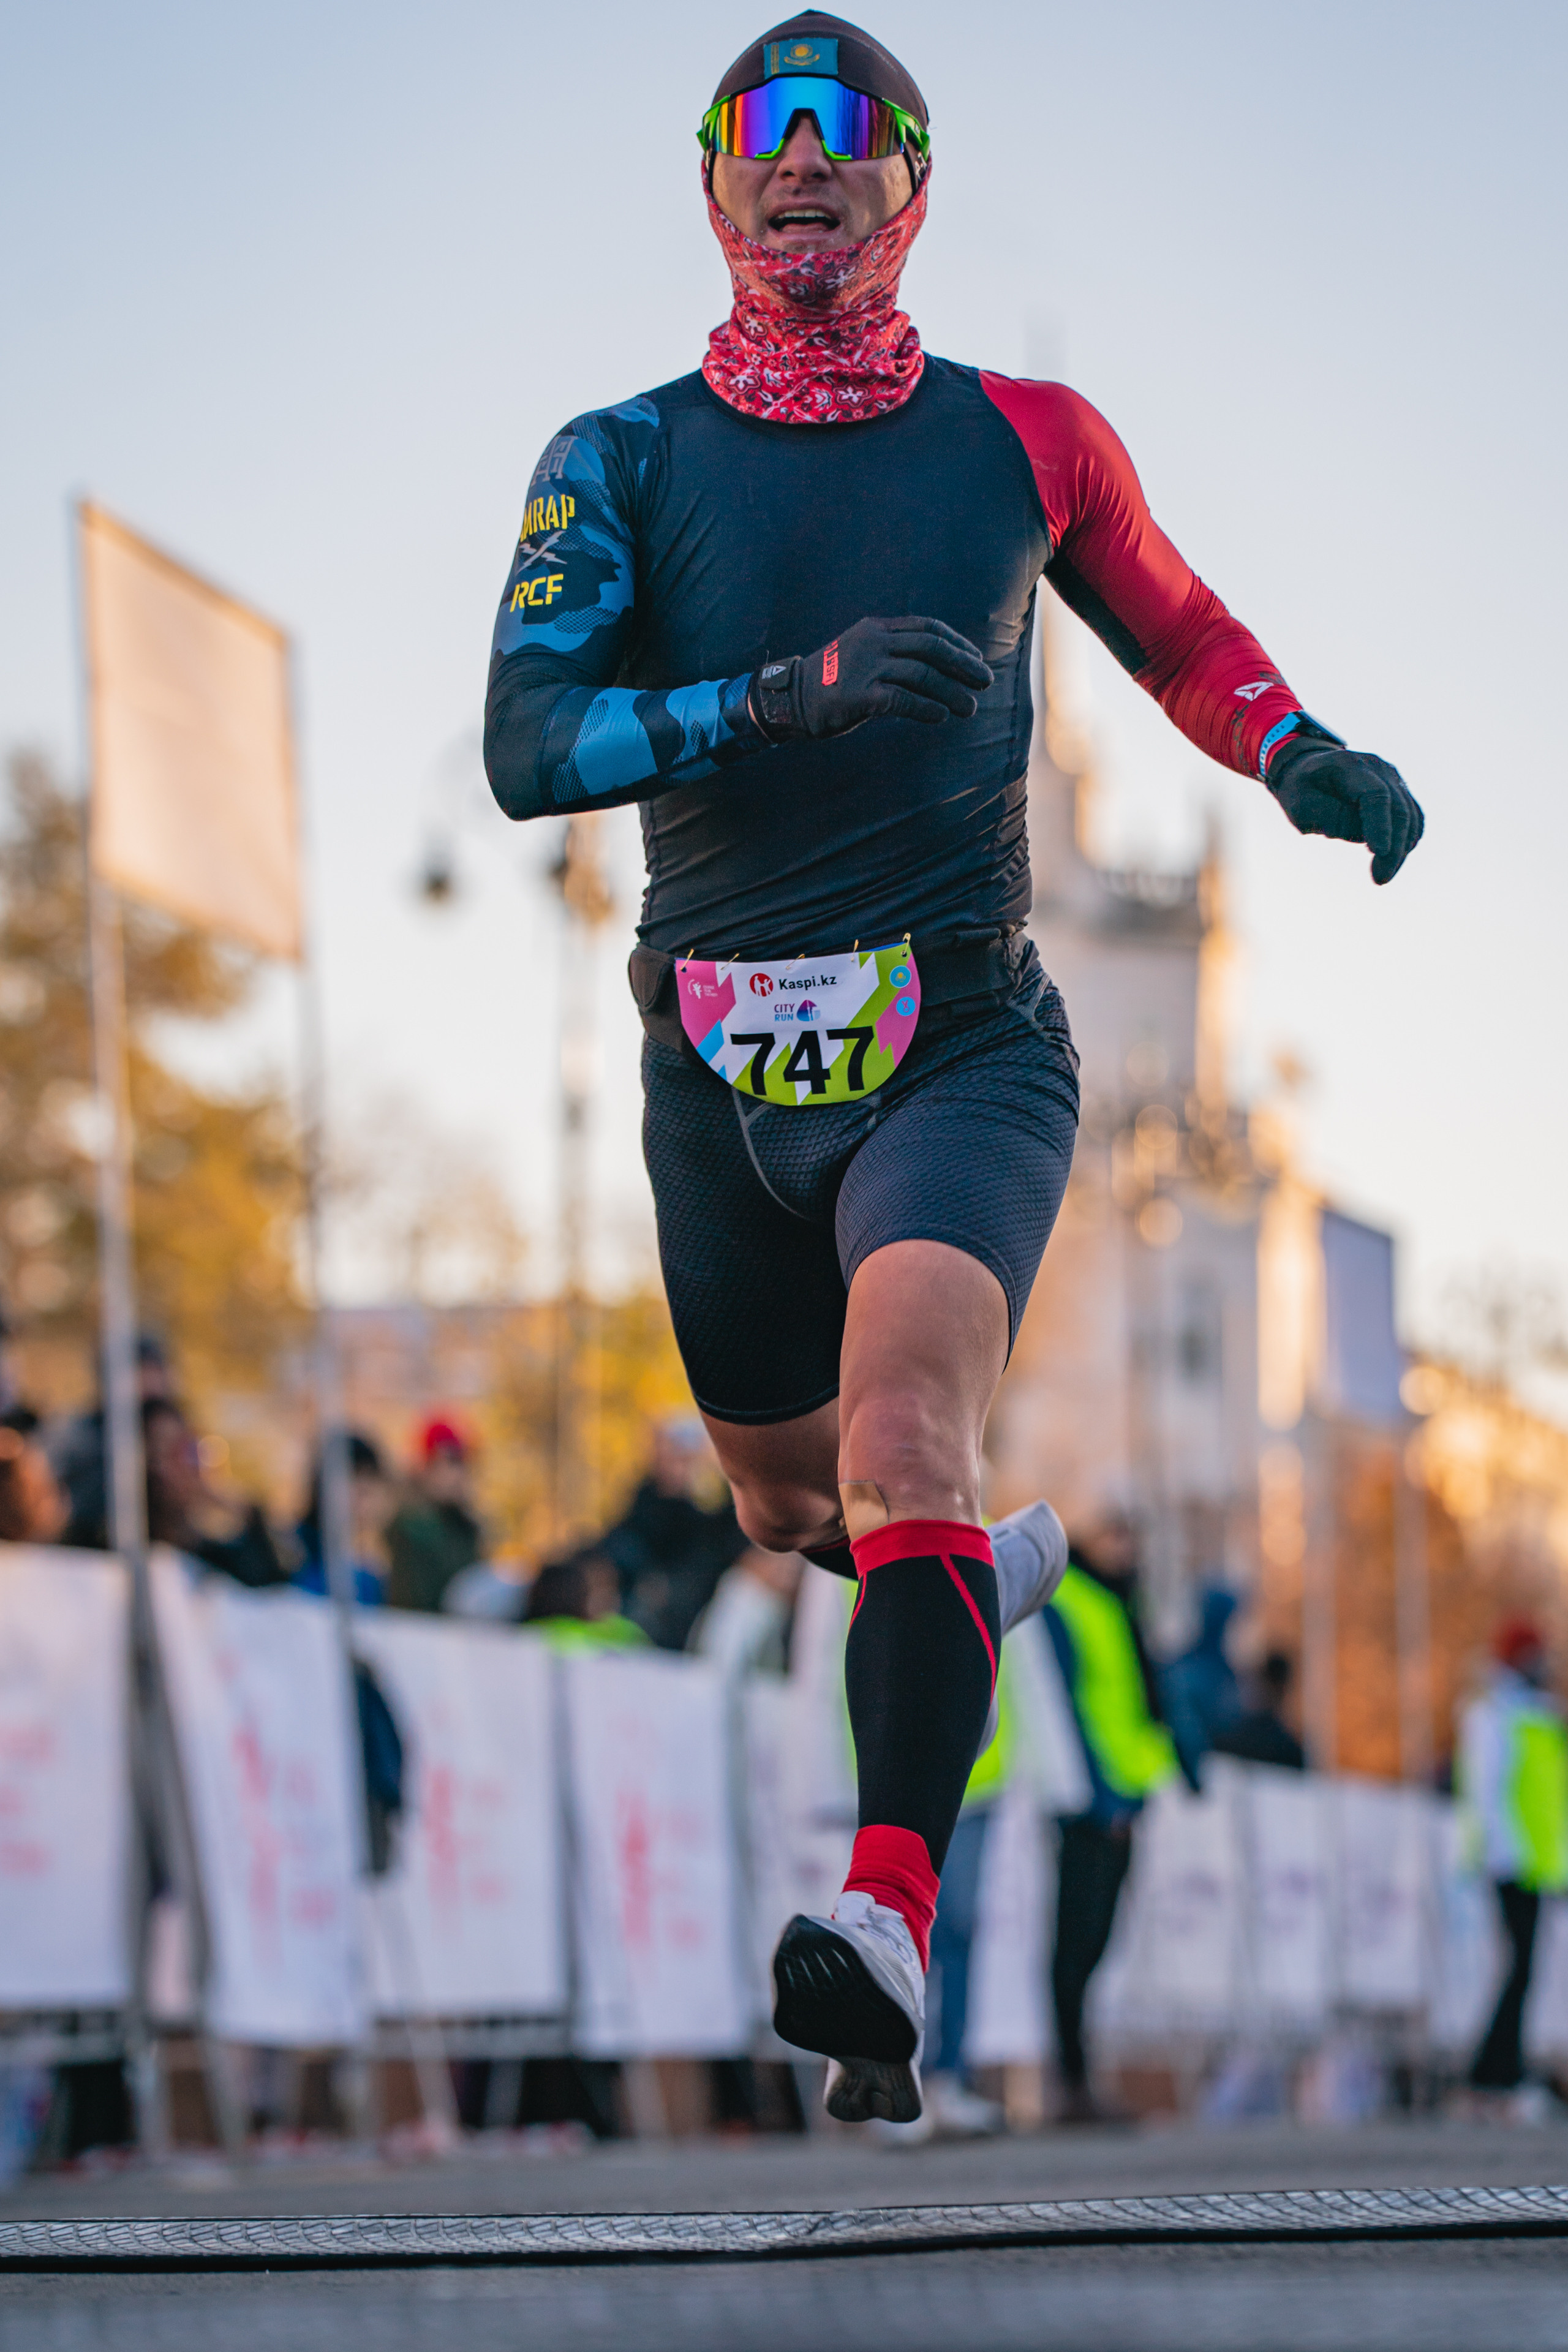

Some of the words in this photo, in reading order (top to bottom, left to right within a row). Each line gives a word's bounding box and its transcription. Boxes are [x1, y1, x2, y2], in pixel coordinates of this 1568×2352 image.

[519, 495, 575, 542] MRAP
[510, 574, 564, 612] RCF
[779, 975, 837, 990] Kaspi.kz
[774, 1003, 796, 1013] CITY
[774, 1014, 794, 1022] RUN
[730, 1026, 875, 1096] 747
